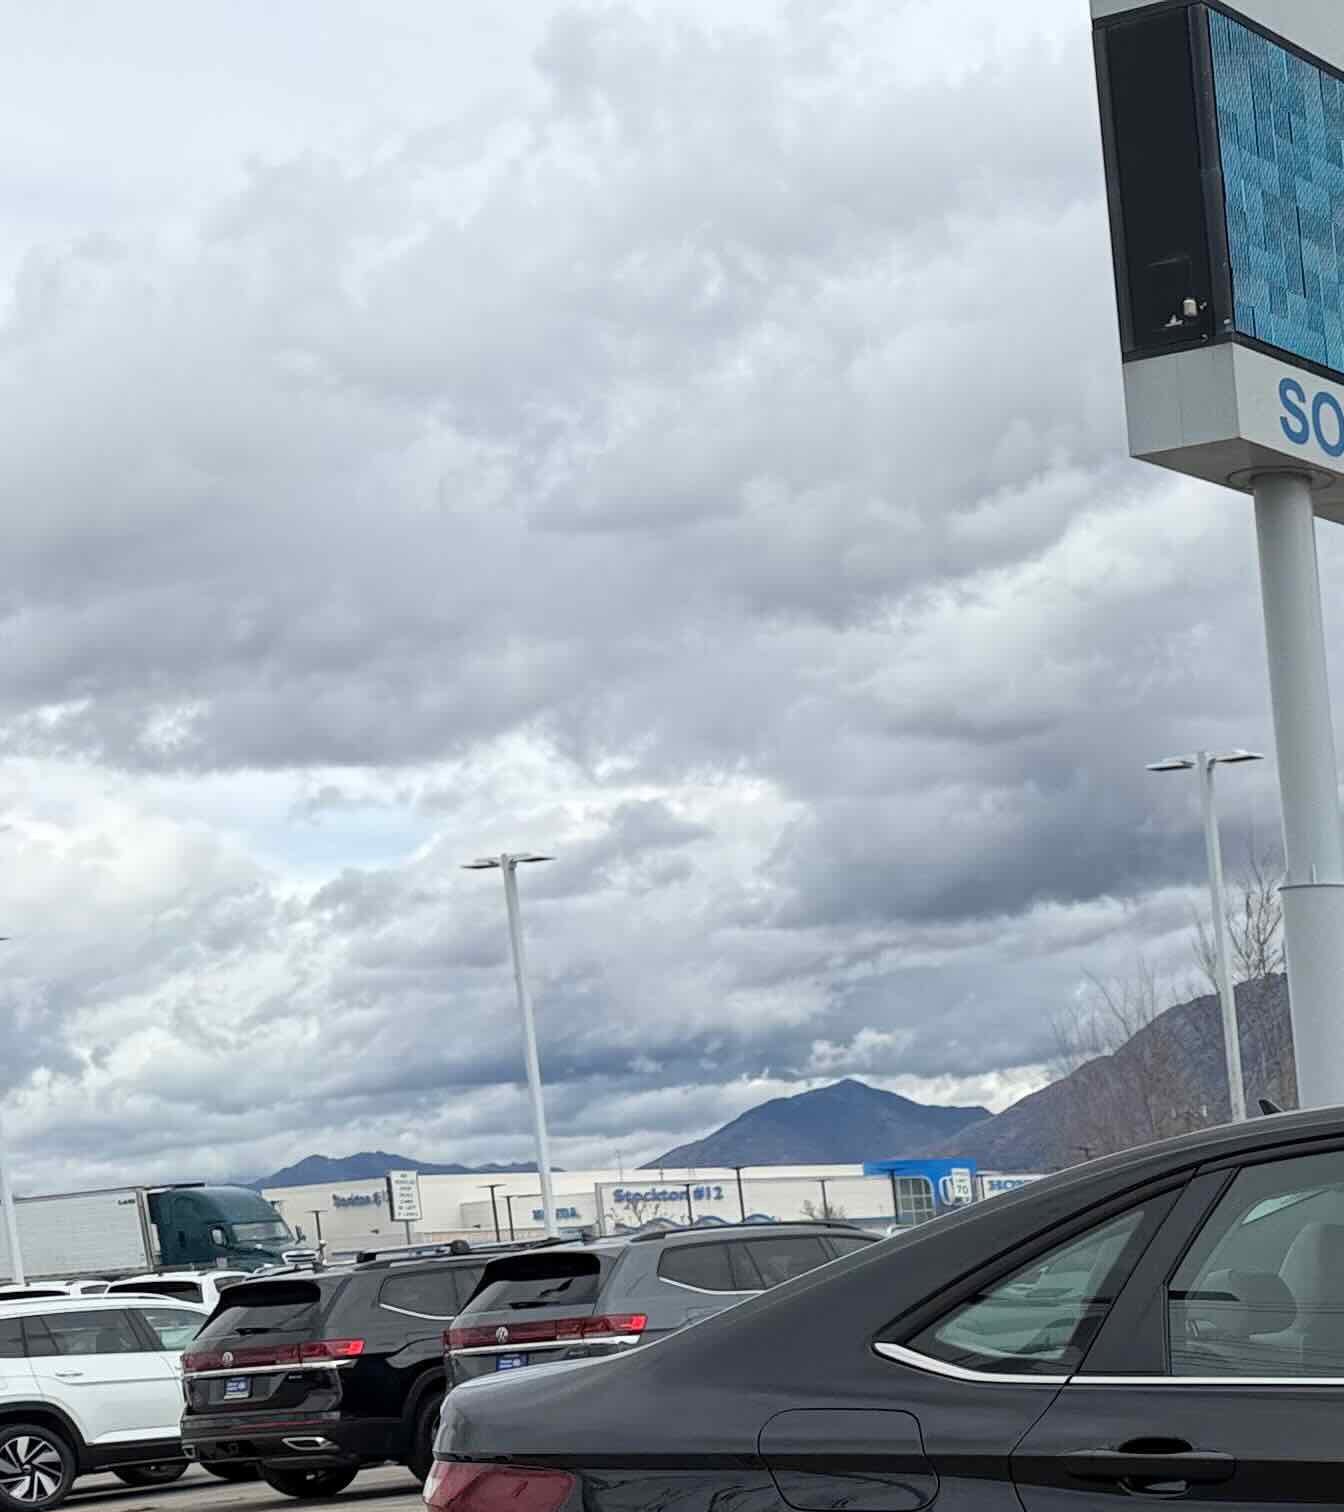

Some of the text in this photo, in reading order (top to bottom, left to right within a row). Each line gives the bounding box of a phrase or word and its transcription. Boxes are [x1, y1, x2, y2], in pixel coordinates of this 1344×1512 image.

[612, 1186, 725, 1203] Stockton #12
[956, 1184, 969, 1194] 70
